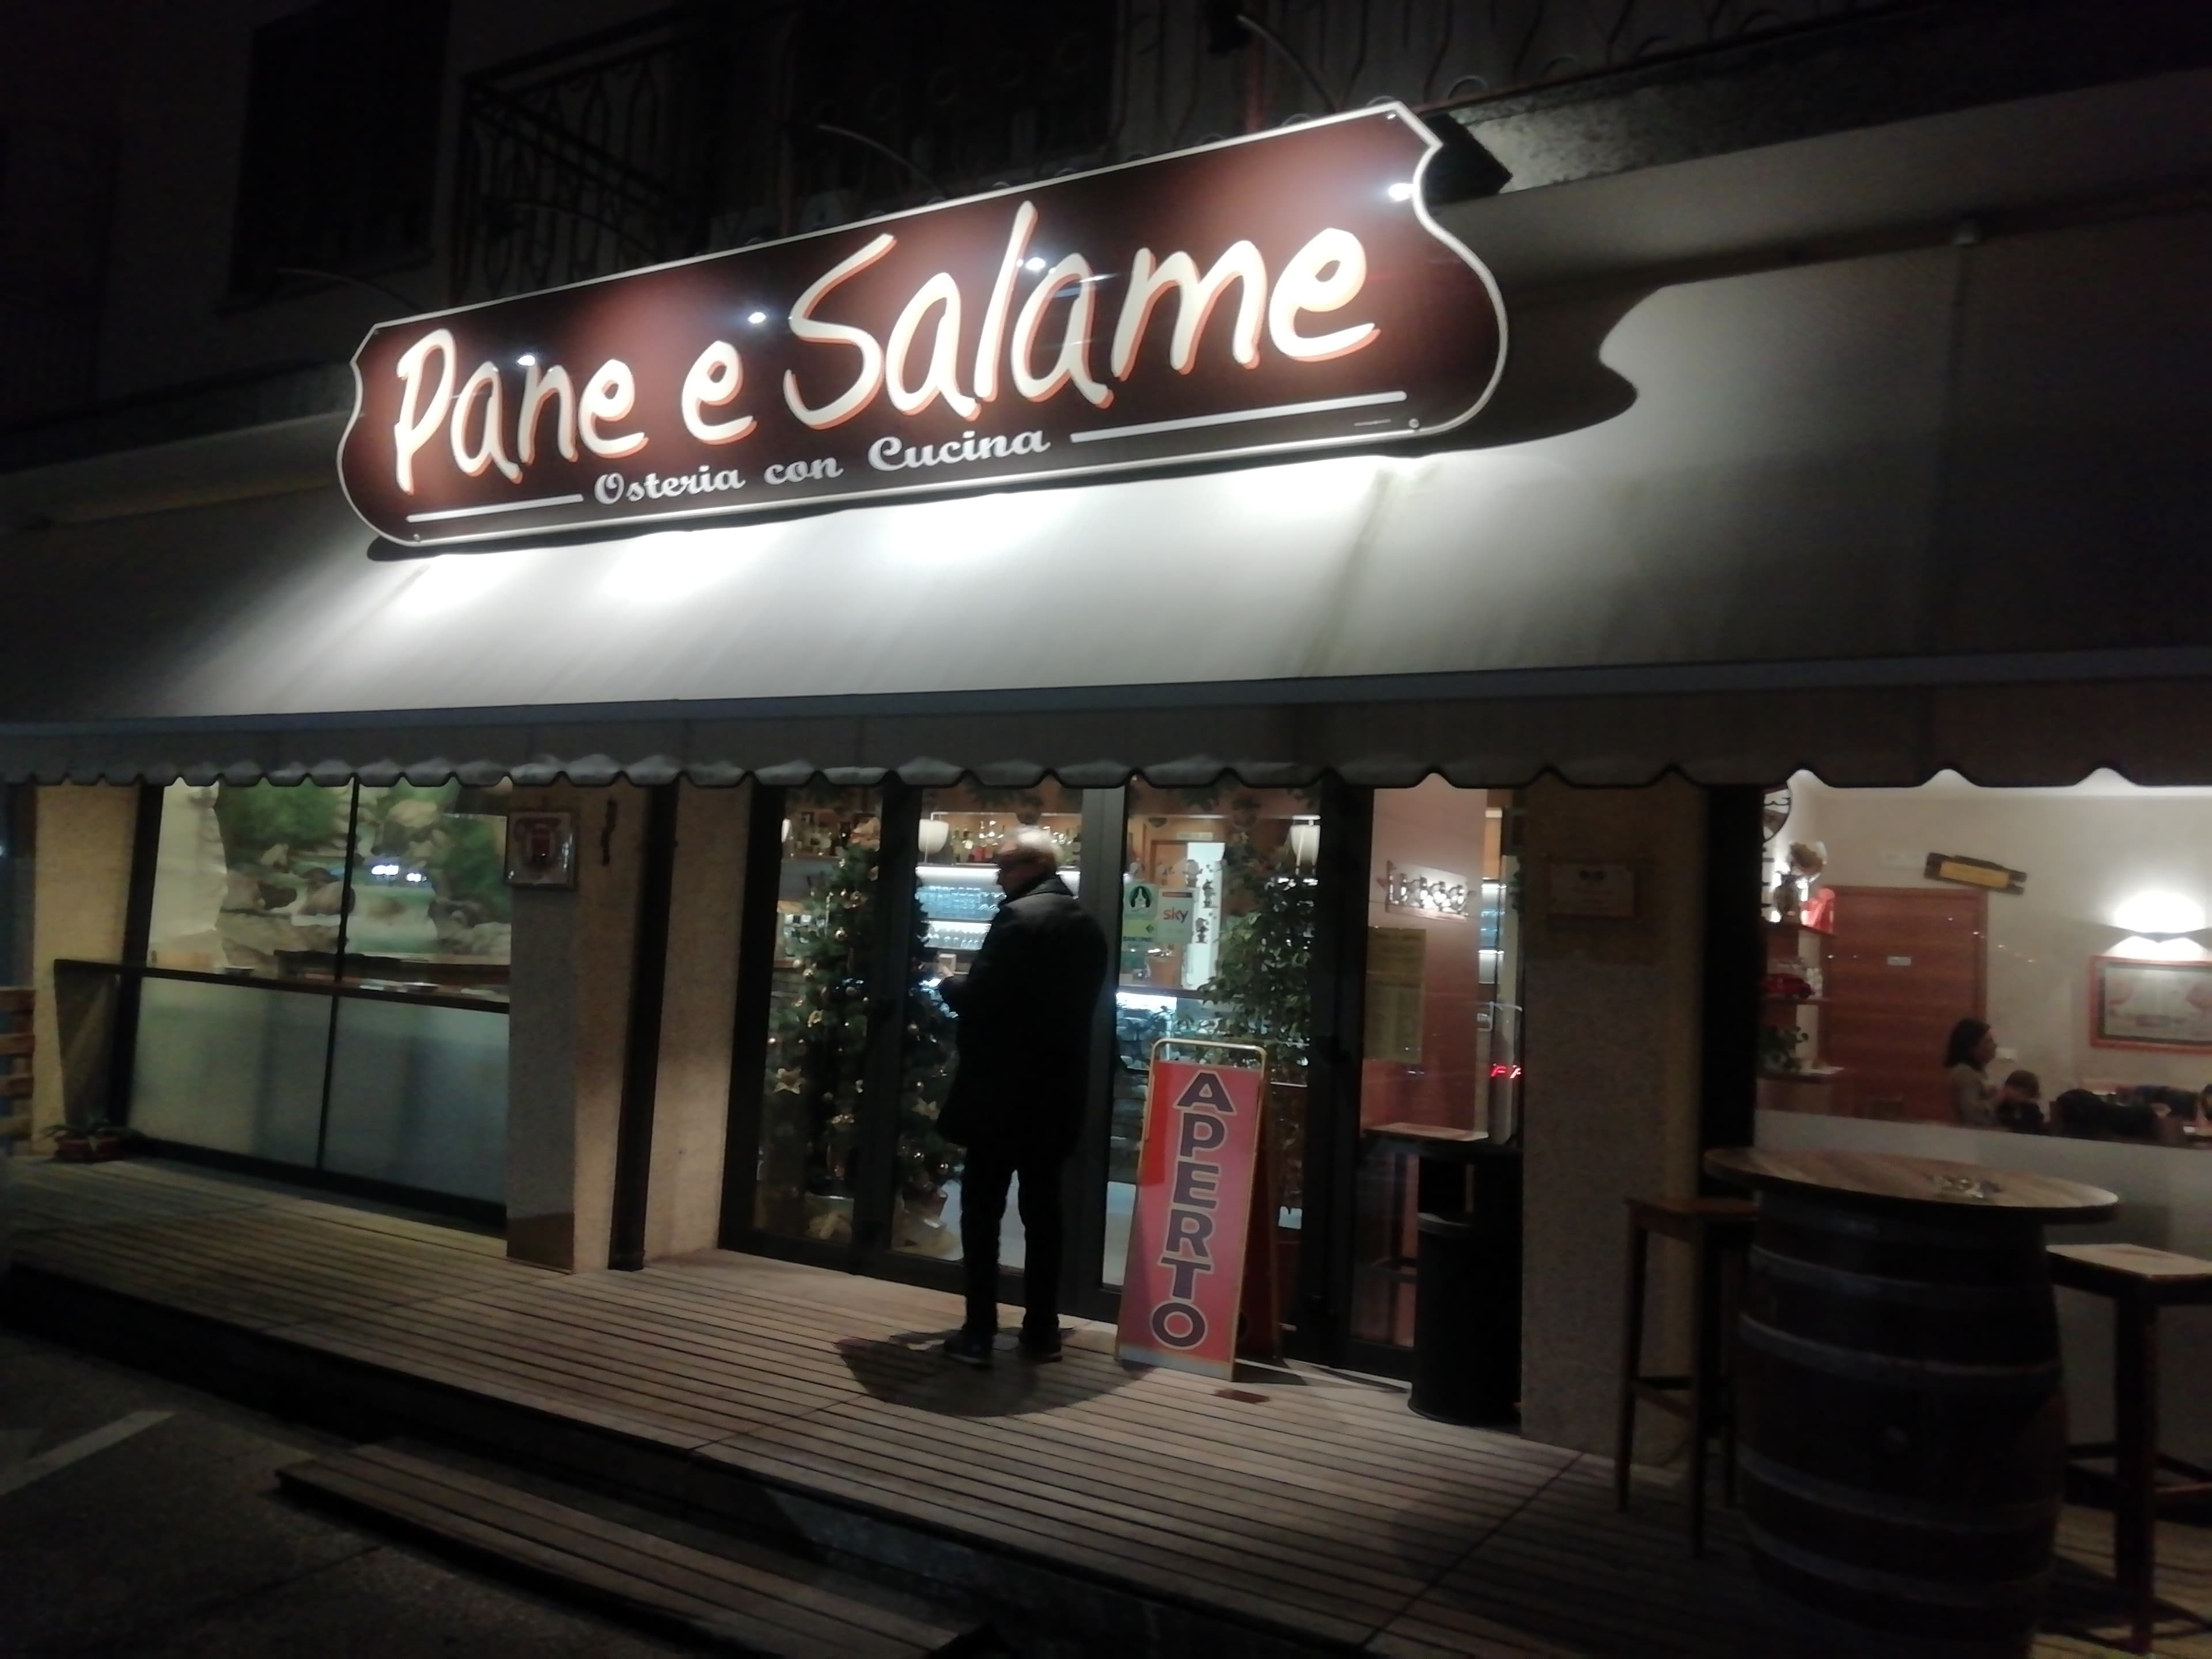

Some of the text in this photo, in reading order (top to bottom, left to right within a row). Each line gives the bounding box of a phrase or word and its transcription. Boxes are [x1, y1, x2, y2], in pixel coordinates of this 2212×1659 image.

[395, 200, 1381, 495] Pane e Salame
[594, 430, 1051, 505] Osteria con Cucina
[1162, 907, 1188, 924] sky
[1150, 1069, 1238, 1351] APERTO
